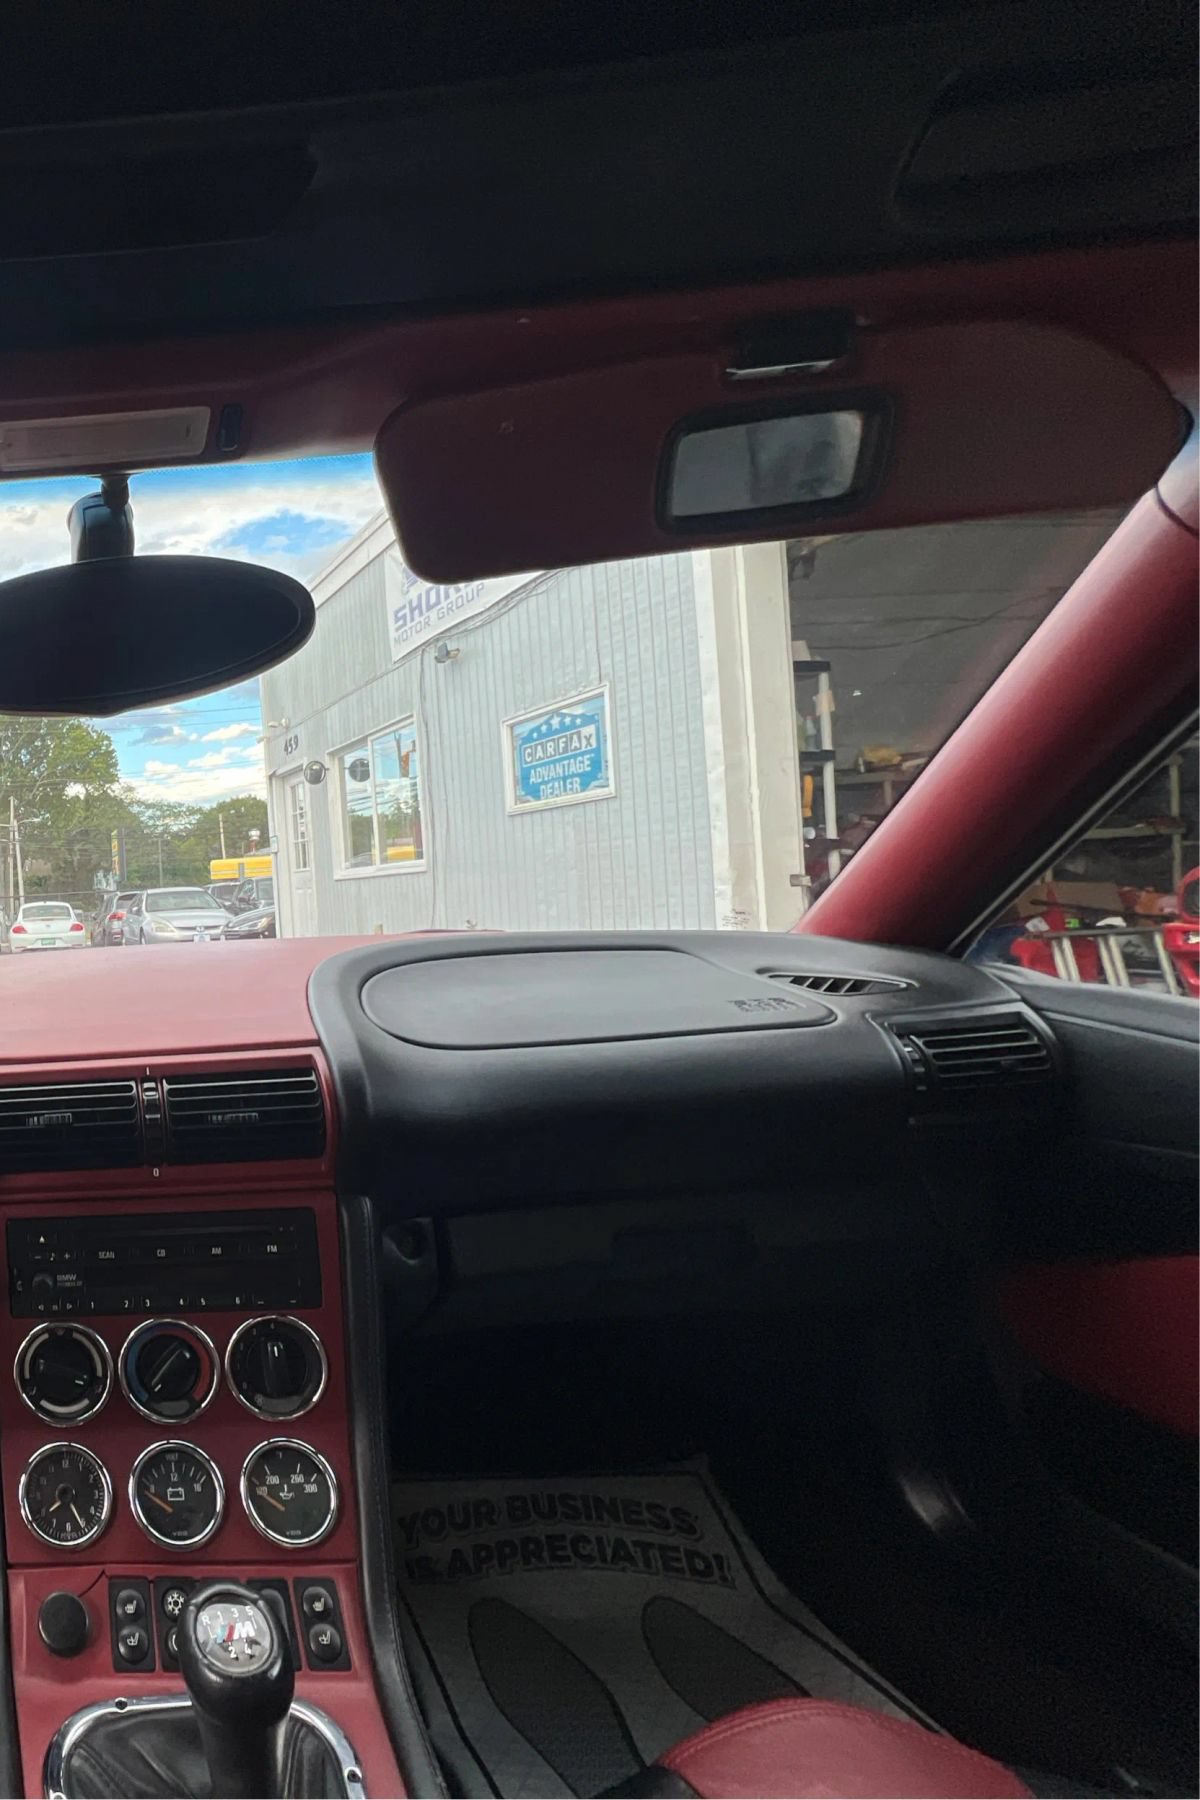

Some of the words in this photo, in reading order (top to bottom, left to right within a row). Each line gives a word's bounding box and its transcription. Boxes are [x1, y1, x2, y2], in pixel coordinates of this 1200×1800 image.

[393, 615, 431, 645] MOTOR
[436, 582, 485, 621] GROUP
[283, 735, 299, 757] 459
[524, 733, 593, 763] CARFAX
[530, 755, 592, 785] ADVANTAGE
[540, 777, 581, 799] DEALER
[156, 1249, 166, 1257] CD
[211, 1247, 222, 1255] AM
[267, 1244, 278, 1253] FM
[98, 1251, 116, 1259] SCAN
[62, 1460, 70, 1469] 12
[170, 1473, 178, 1482] 12
[265, 1475, 280, 1485] 200
[303, 1483, 317, 1493] 300
[89, 1505, 95, 1515] 4
[397, 1498, 500, 1547] YOUR
[505, 1490, 702, 1540] BUSINESS
[403, 1555, 443, 1584] IS
[446, 1533, 733, 1587] APPRECIATED!
[231, 1607, 239, 1618] 3
[245, 1606, 253, 1616] 5
[201, 1615, 211, 1626] R
[233, 1620, 256, 1640] M
[228, 1646, 237, 1658] 2
[244, 1643, 252, 1654] 4
